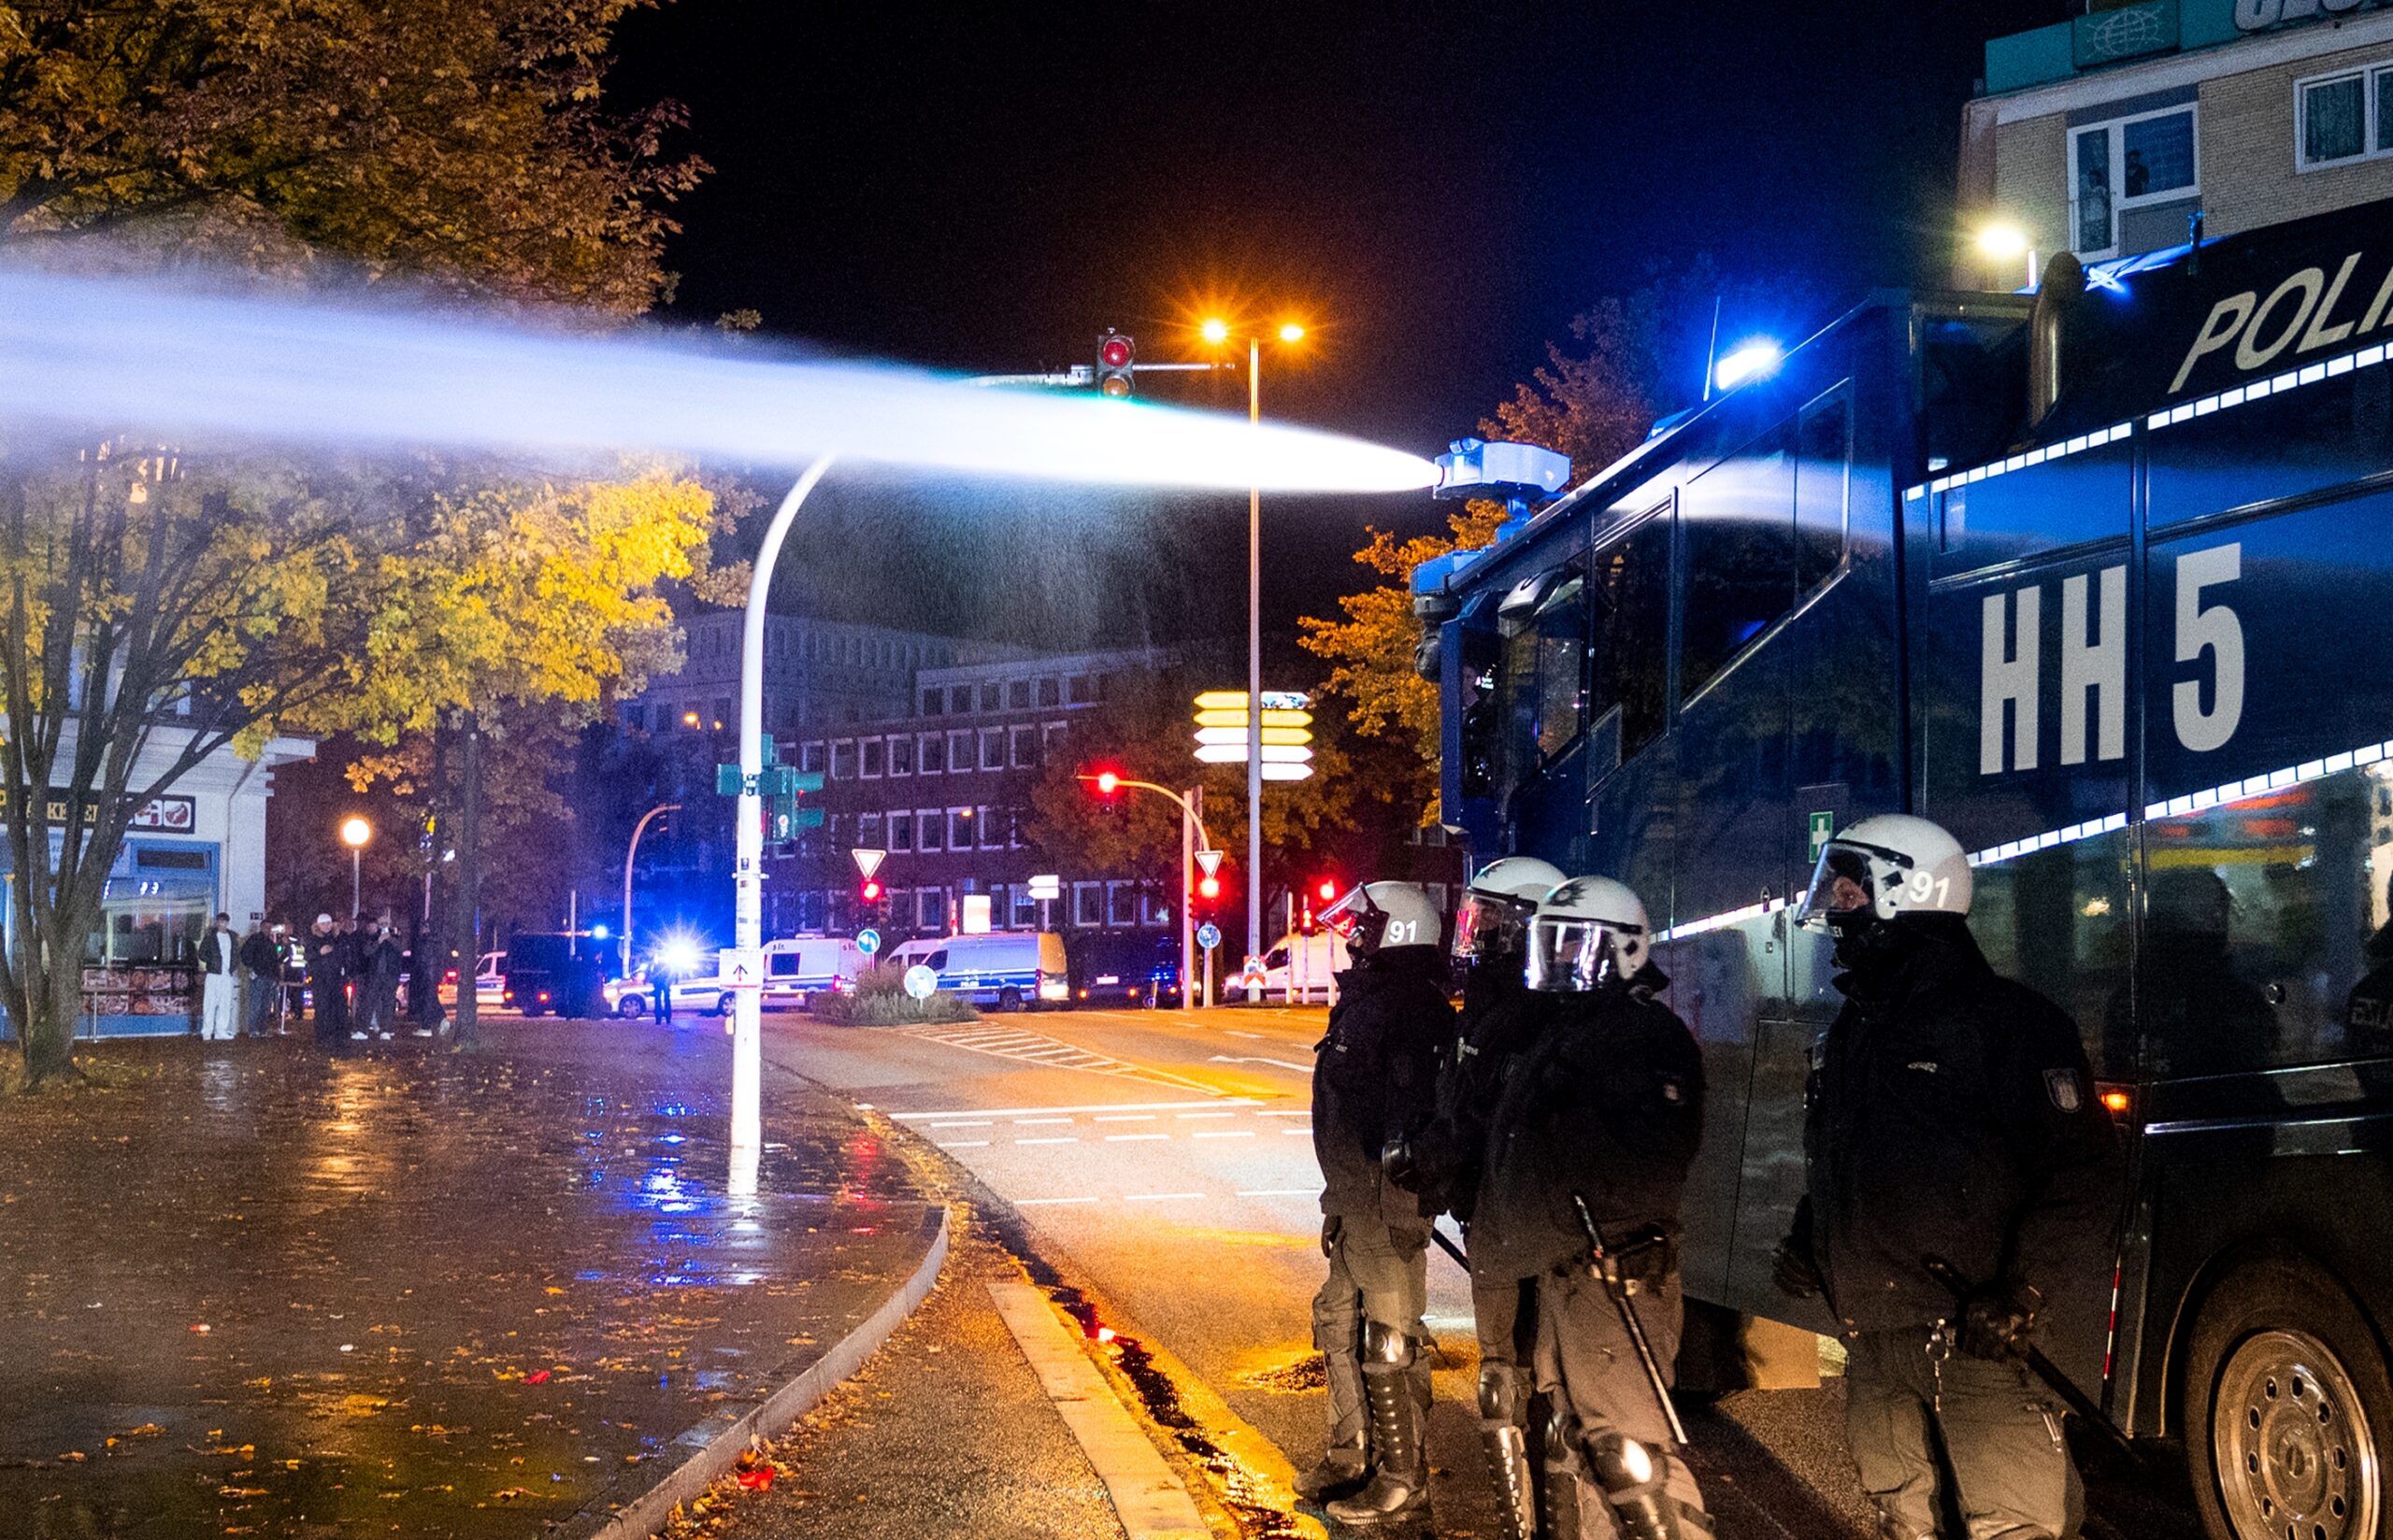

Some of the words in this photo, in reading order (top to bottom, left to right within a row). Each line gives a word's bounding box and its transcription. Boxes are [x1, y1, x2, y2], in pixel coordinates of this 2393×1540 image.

[2168, 252, 2393, 393] POLI
[1981, 565, 2127, 775] HH
[2172, 542, 2244, 752] 5
[1388, 920, 1417, 944] 91
[1909, 870, 1951, 908] 91
